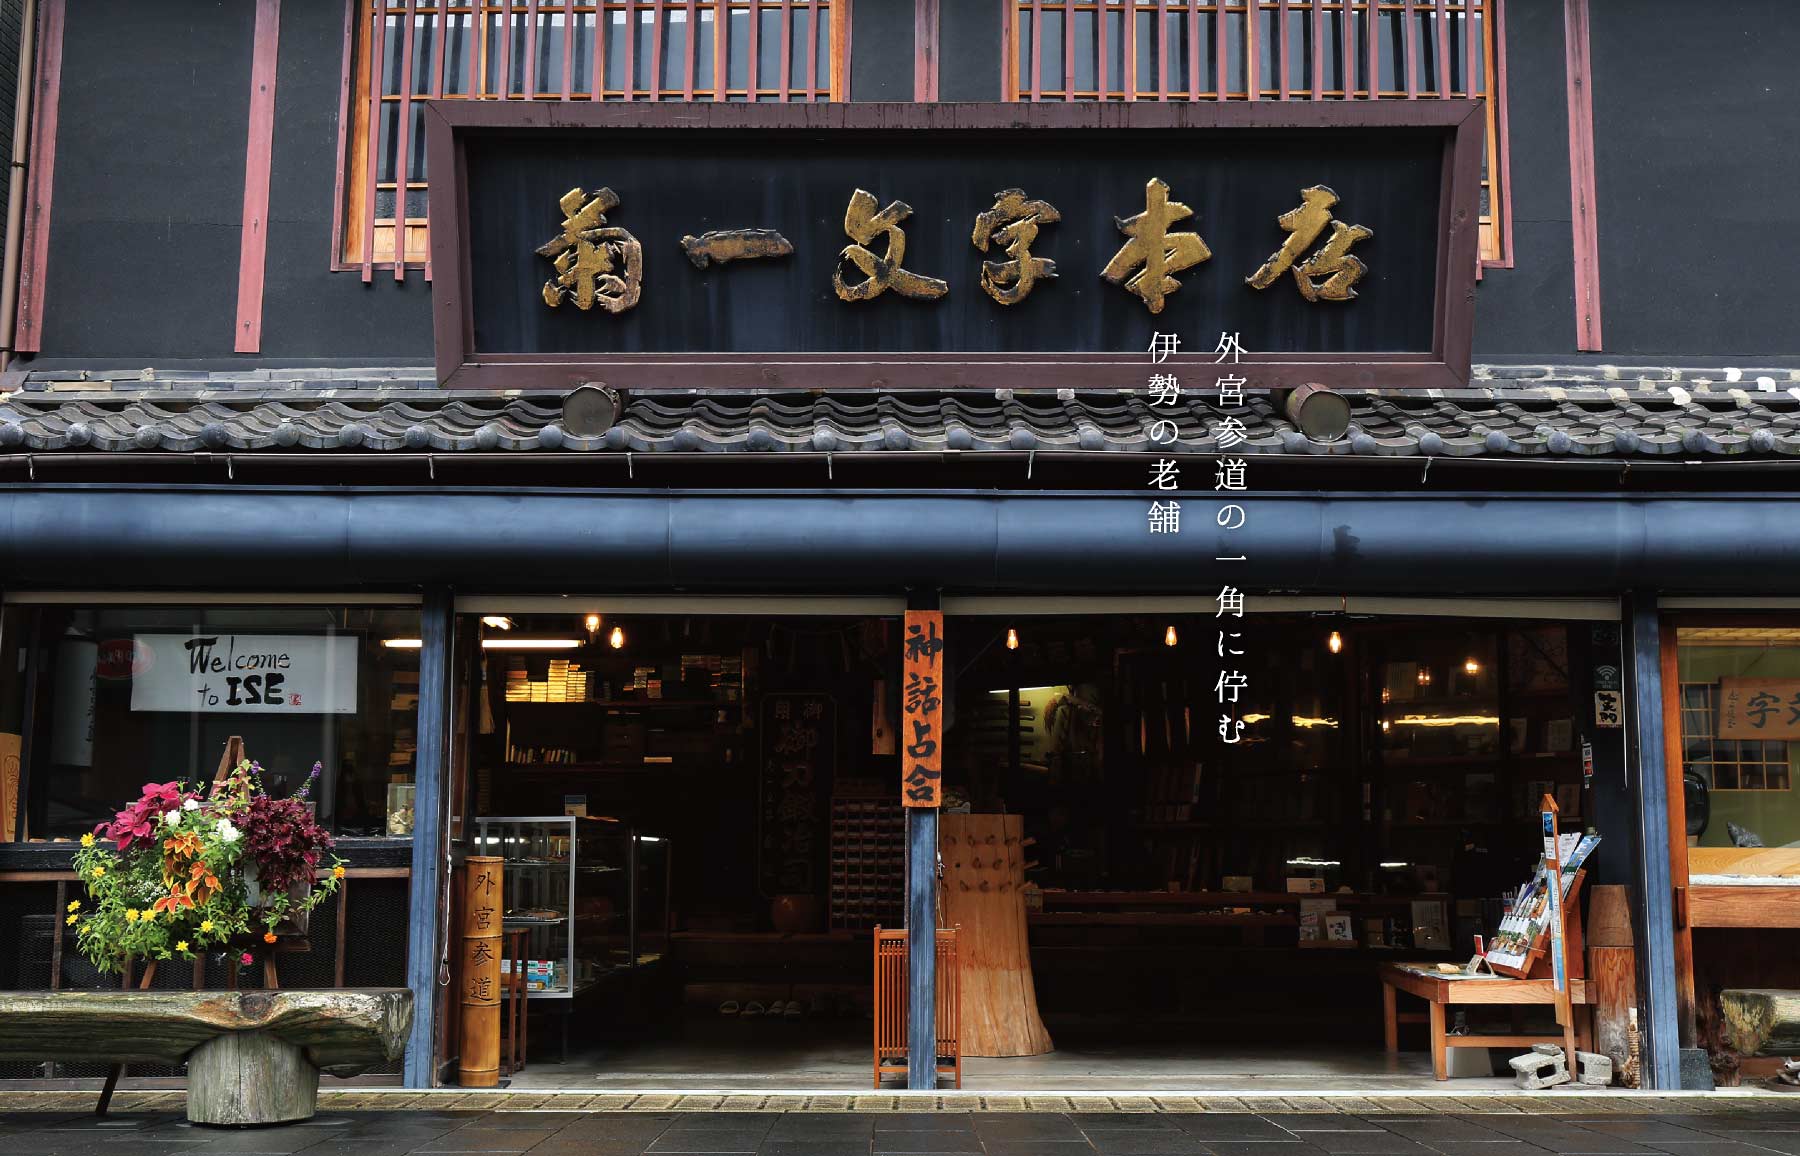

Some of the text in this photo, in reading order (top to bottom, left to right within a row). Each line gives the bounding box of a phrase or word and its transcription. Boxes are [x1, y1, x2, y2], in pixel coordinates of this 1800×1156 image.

[535, 177, 1374, 315] 菊一文字本店
[184, 636, 291, 674] Welcome
[197, 683, 219, 707] to
[226, 672, 285, 705] ISE
[904, 620, 943, 802] 神話占合
[470, 871, 496, 1001] 外宮参道
